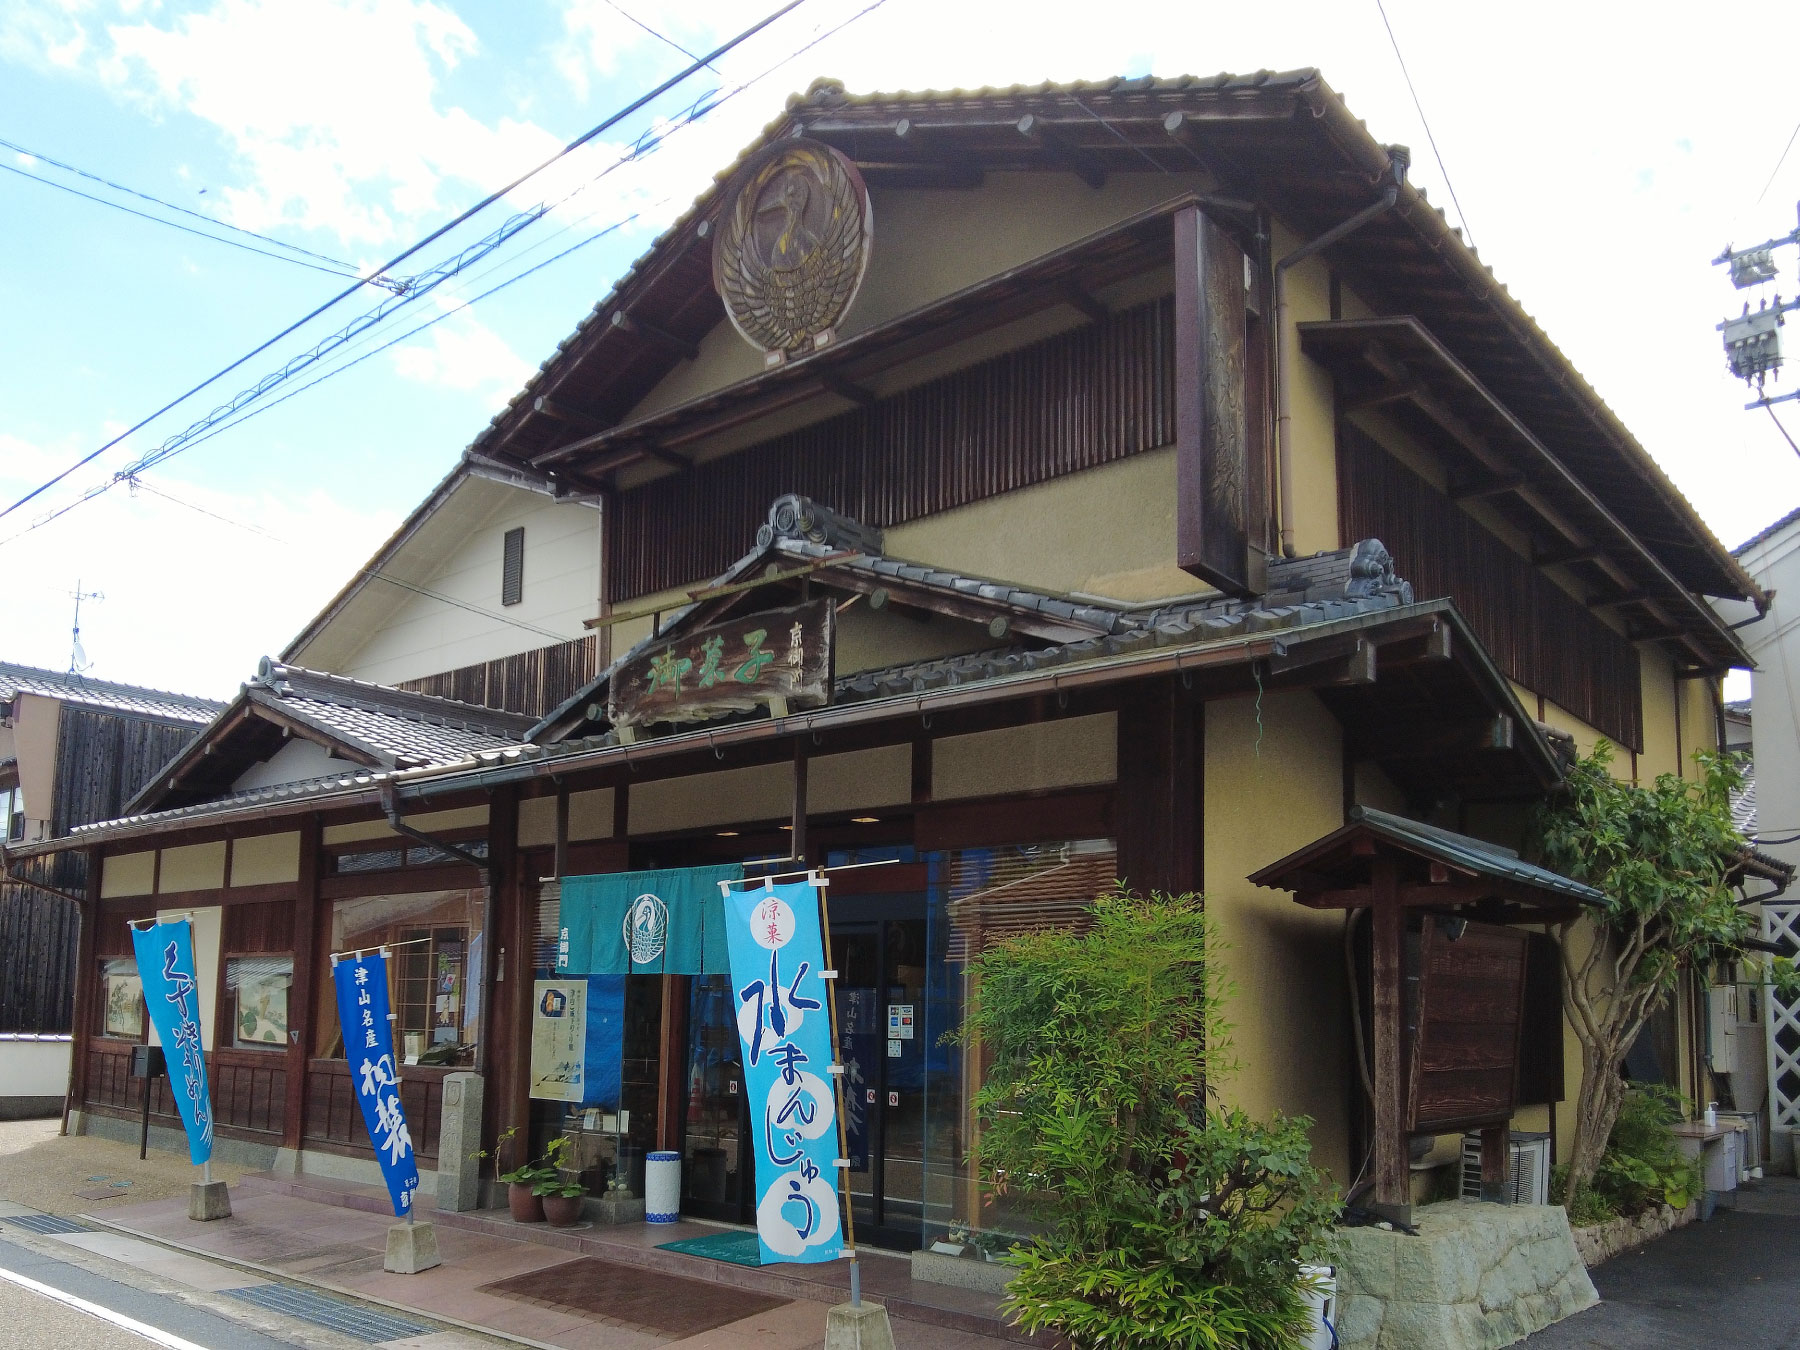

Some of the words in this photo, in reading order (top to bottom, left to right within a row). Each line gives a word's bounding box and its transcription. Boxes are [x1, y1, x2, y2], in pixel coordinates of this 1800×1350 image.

[646, 628, 775, 701] 御菓子
[558, 927, 569, 968] 京御門
[761, 899, 783, 944] 涼菓
[354, 967, 379, 1049] 津山名産
[739, 948, 822, 1241] 水まんじゅう
